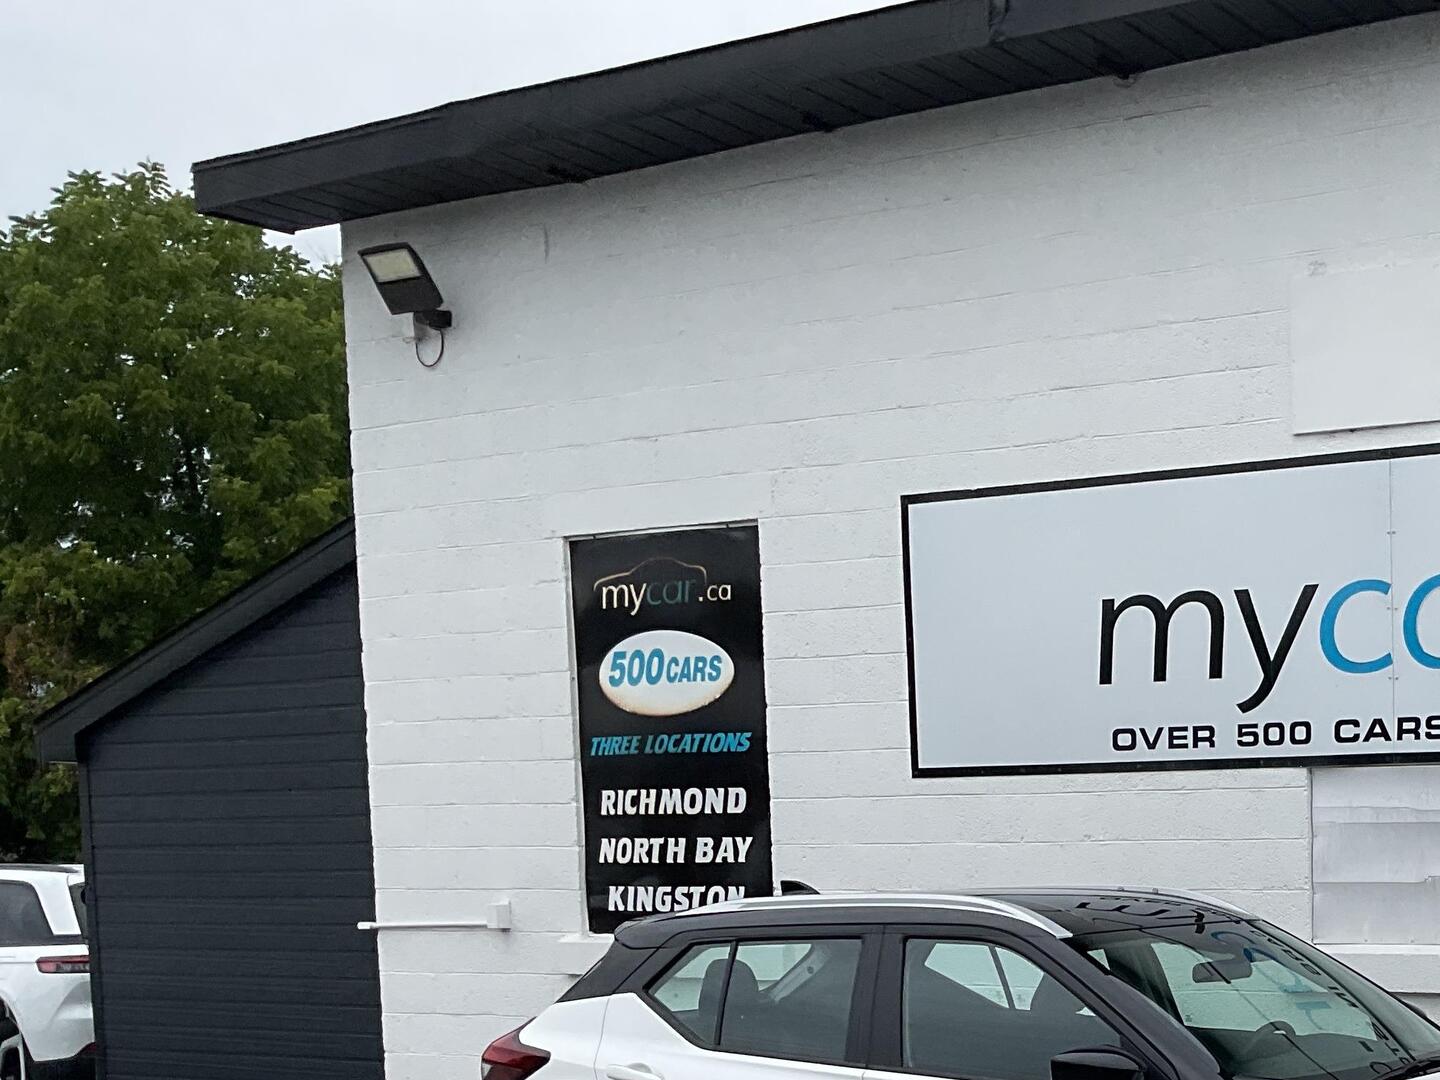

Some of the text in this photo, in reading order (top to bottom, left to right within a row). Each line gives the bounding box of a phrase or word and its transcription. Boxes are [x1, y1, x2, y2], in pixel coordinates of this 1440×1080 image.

[608, 648, 722, 688] 500 CARS
[590, 732, 753, 756] THREE LOCATIONS
[1111, 725, 1216, 752] OVER
[1236, 720, 1312, 747] 500
[600, 787, 747, 816] RICHMOND
[598, 836, 753, 864] NORTH BAY
[607, 885, 746, 912] KINGSTON
